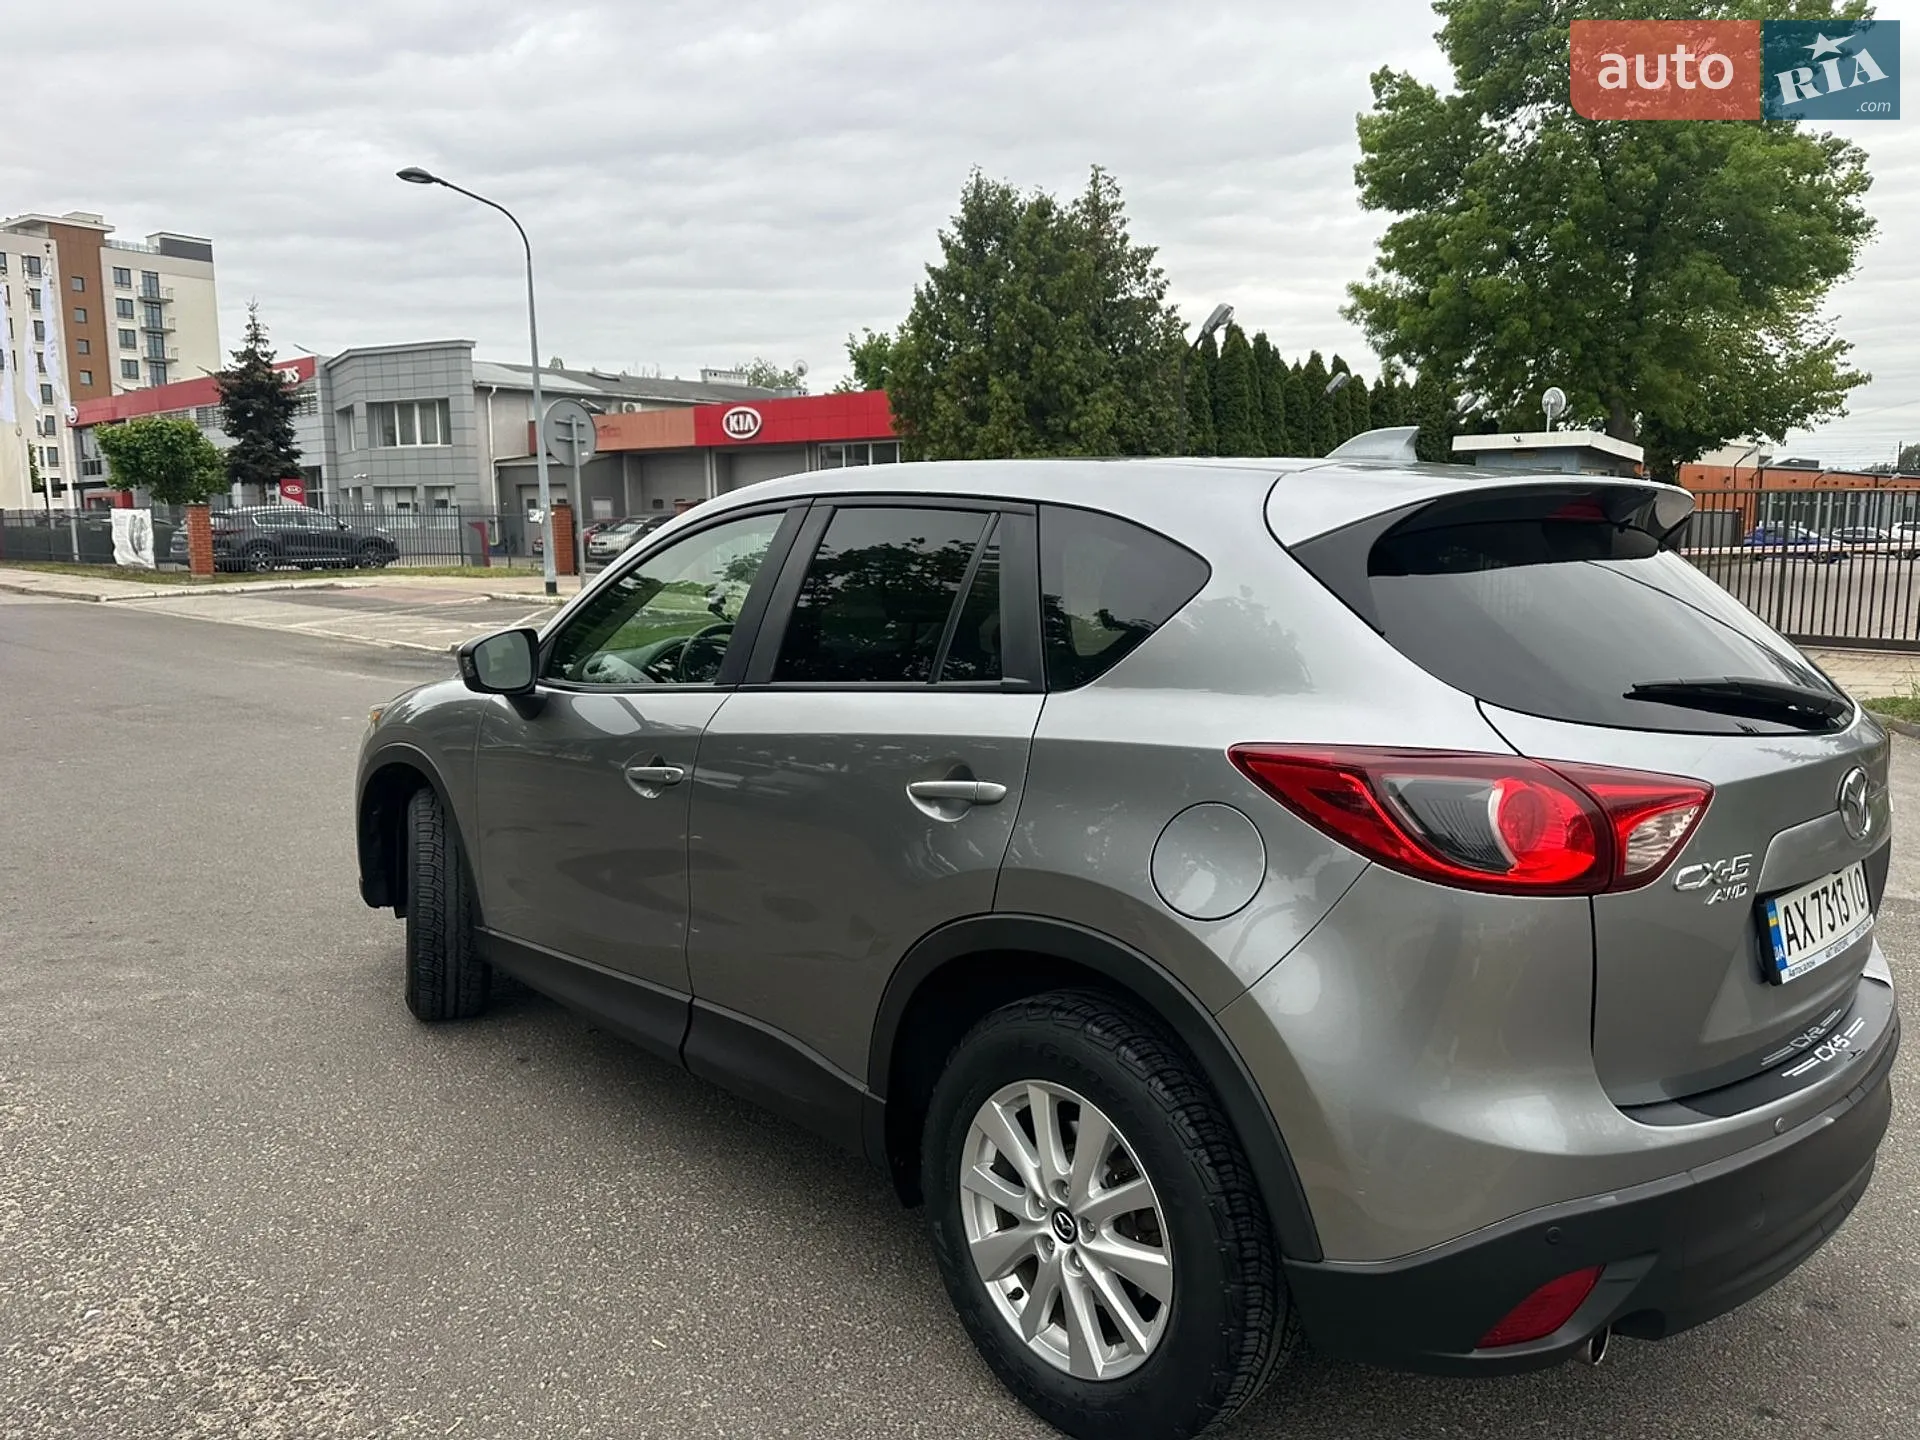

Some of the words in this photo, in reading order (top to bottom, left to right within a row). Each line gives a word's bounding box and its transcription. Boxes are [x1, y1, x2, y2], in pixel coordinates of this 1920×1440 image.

[729, 413, 755, 432] KIA
[1675, 853, 1753, 891] CX-5
[1706, 882, 1748, 905] AWD
[1783, 896, 1816, 956] AX
